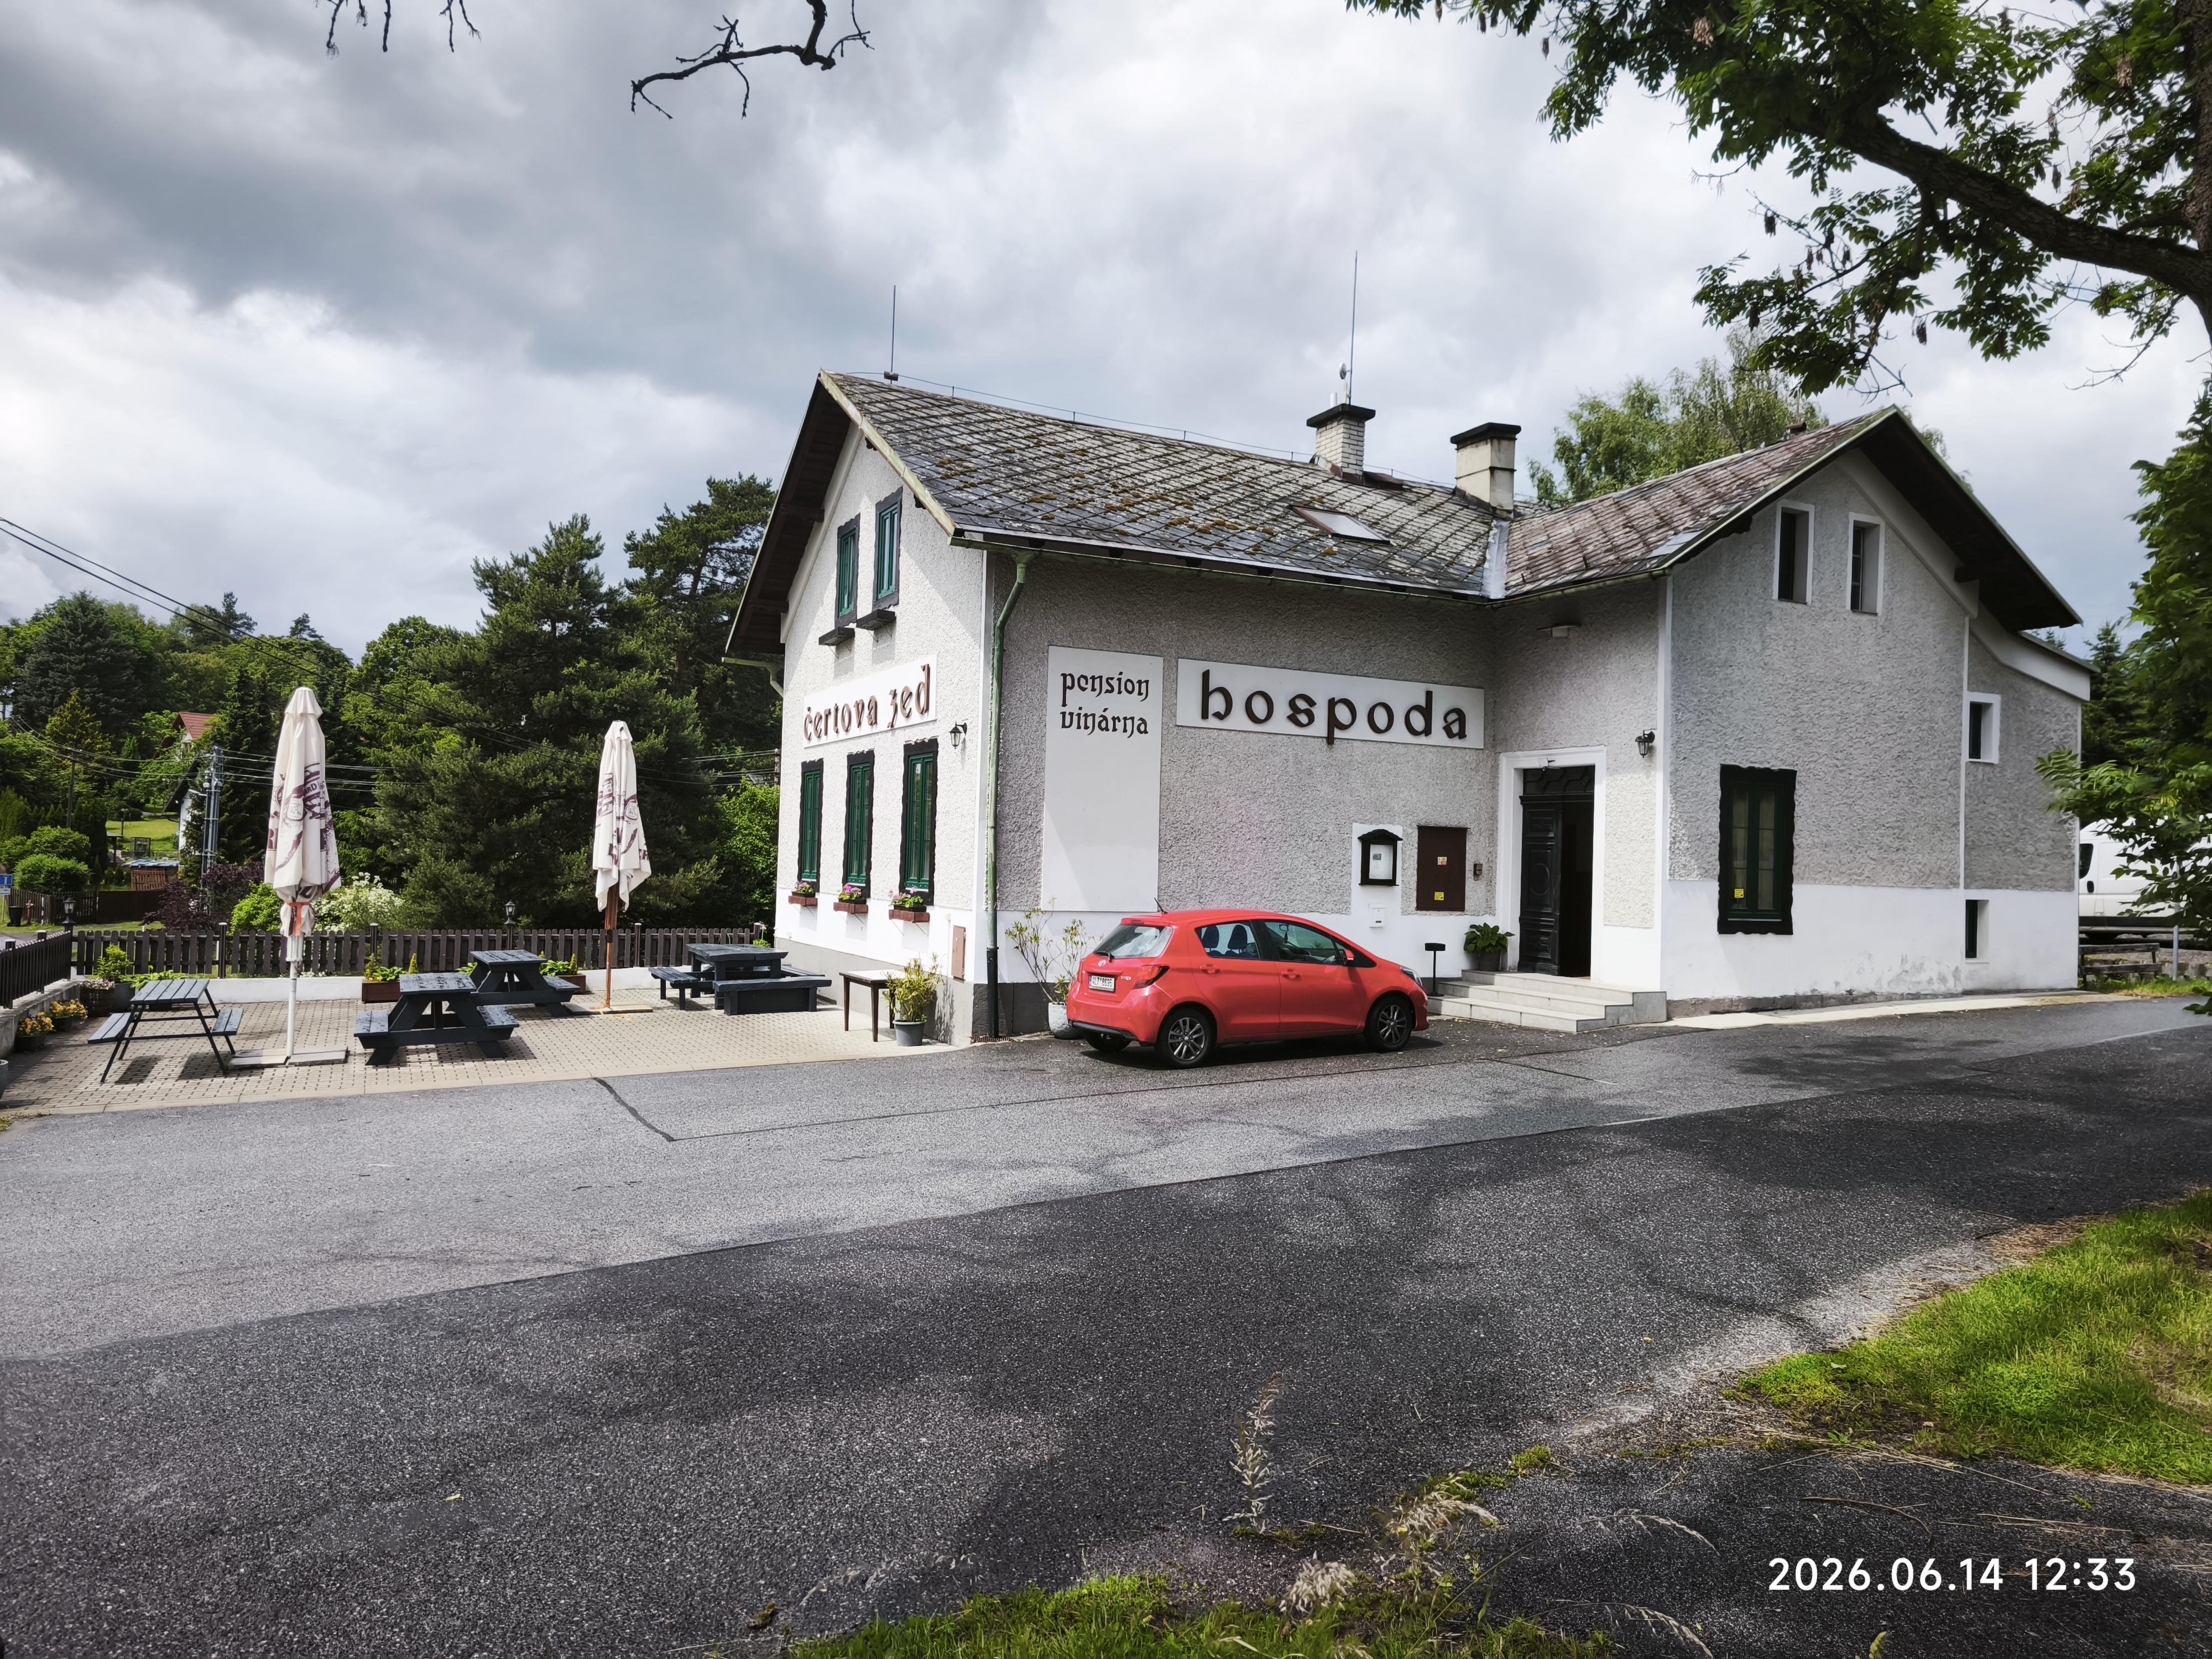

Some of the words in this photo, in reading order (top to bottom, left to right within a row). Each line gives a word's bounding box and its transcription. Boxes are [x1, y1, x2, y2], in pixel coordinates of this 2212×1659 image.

[1060, 671, 1150, 707] pension
[1201, 669, 1467, 745] hospoda
[1060, 706, 1149, 738] vinárna
